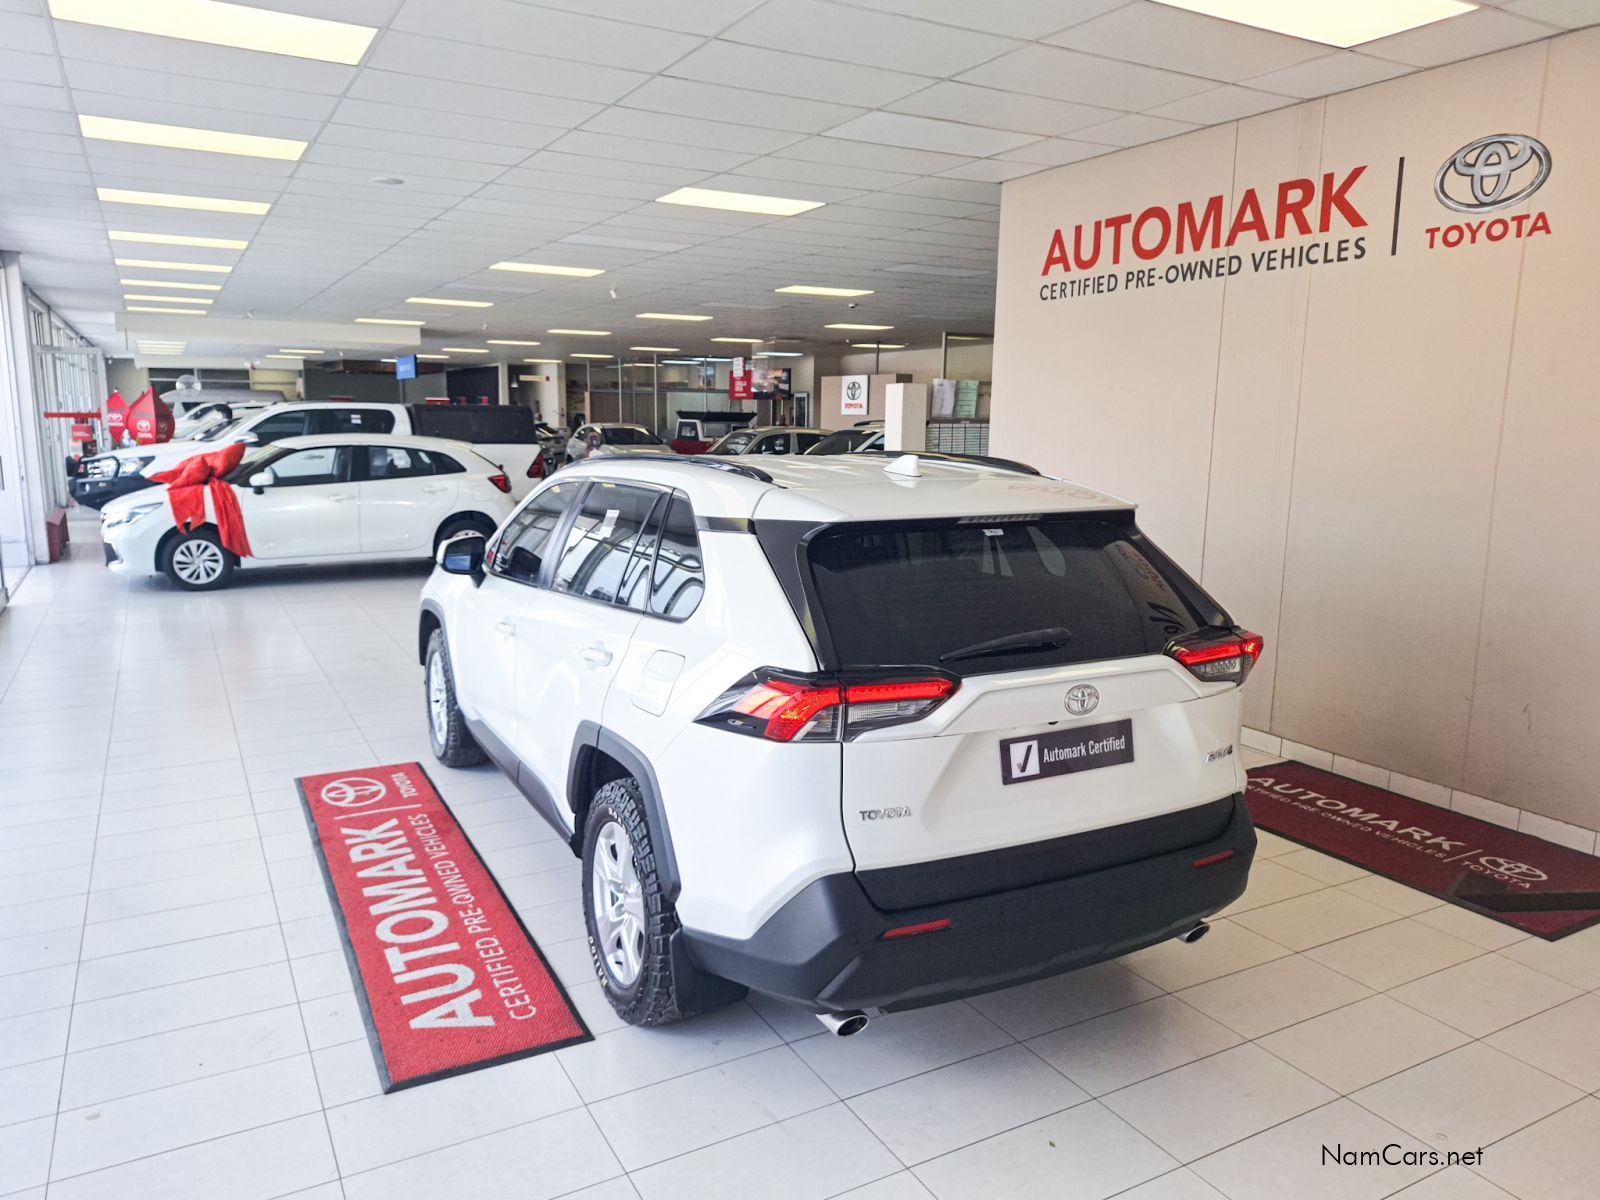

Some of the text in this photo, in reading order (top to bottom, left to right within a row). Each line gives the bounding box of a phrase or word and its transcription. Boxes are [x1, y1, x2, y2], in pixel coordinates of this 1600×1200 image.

[1041, 165, 1369, 276] AUTOMARK
[1425, 211, 1552, 249] TOYOTA
[1039, 237, 1367, 301] CERTIFIED PRE-OWNED VEHICLES
[1043, 735, 1126, 763] Automark Certified
[391, 771, 419, 799] TOYOTA
[859, 806, 912, 821] TOYOTA
[1246, 777, 1467, 851] AUTOMARK
[1374, 830, 1447, 859] VEHICLES
[1461, 860, 1530, 889] TOYOTA
[339, 817, 497, 1030] AUTOMARK
[408, 812, 538, 1020] CERTIFIED PRE-OWNED VEHICLES
